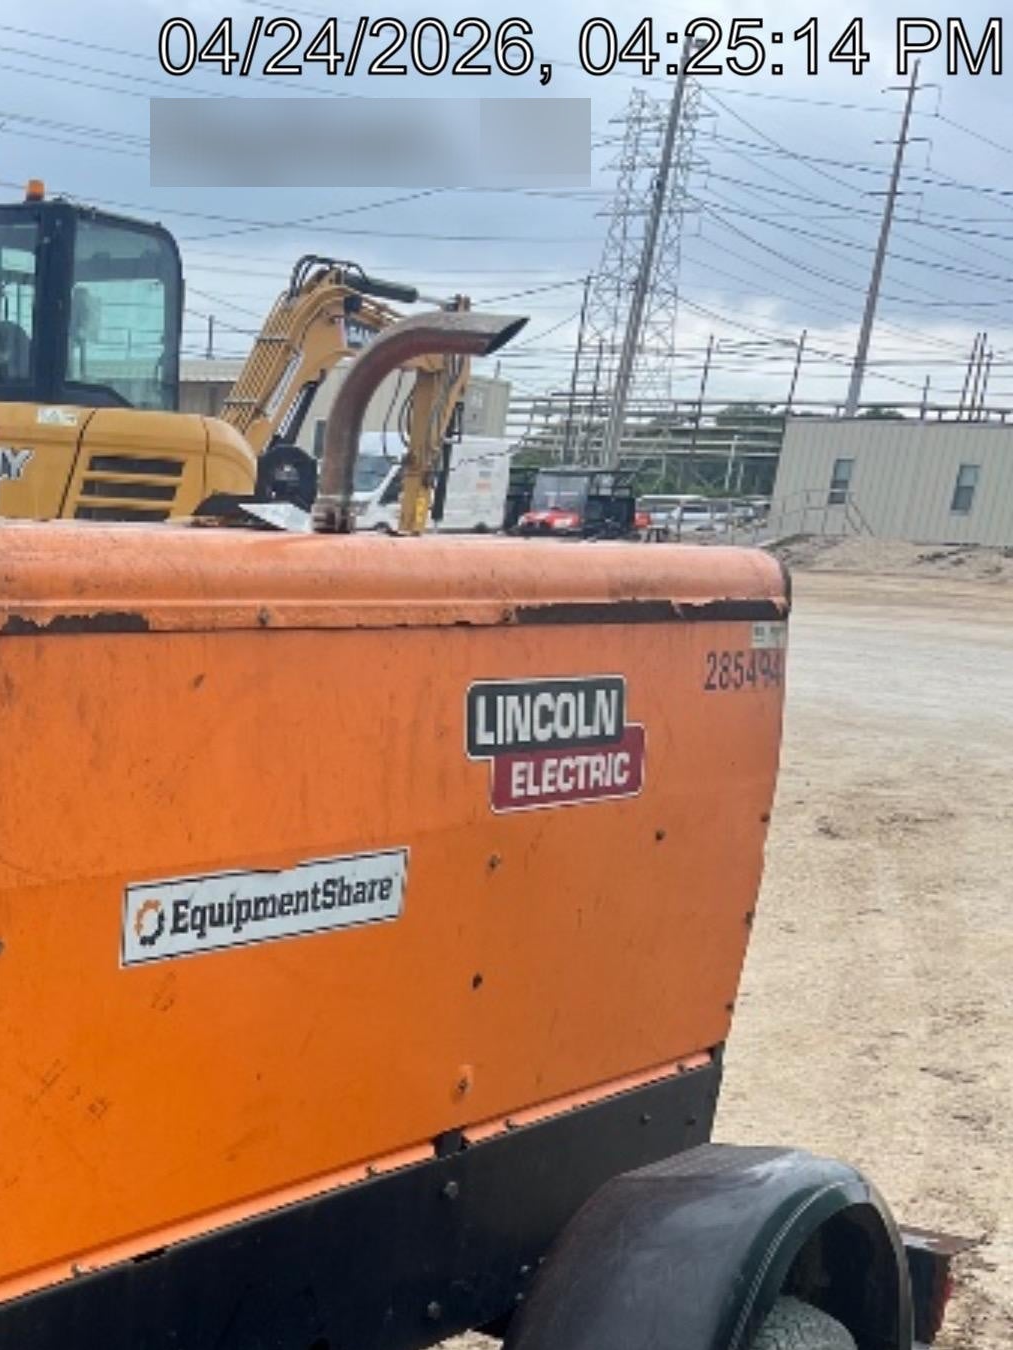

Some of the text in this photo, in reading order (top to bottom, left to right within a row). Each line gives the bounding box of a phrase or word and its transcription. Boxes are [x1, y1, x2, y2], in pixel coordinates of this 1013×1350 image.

[703, 650, 782, 691] 285494
[475, 689, 620, 746] LINCOLN
[511, 752, 631, 799] ELECTRIC
[169, 875, 393, 939] EquipmentShare
